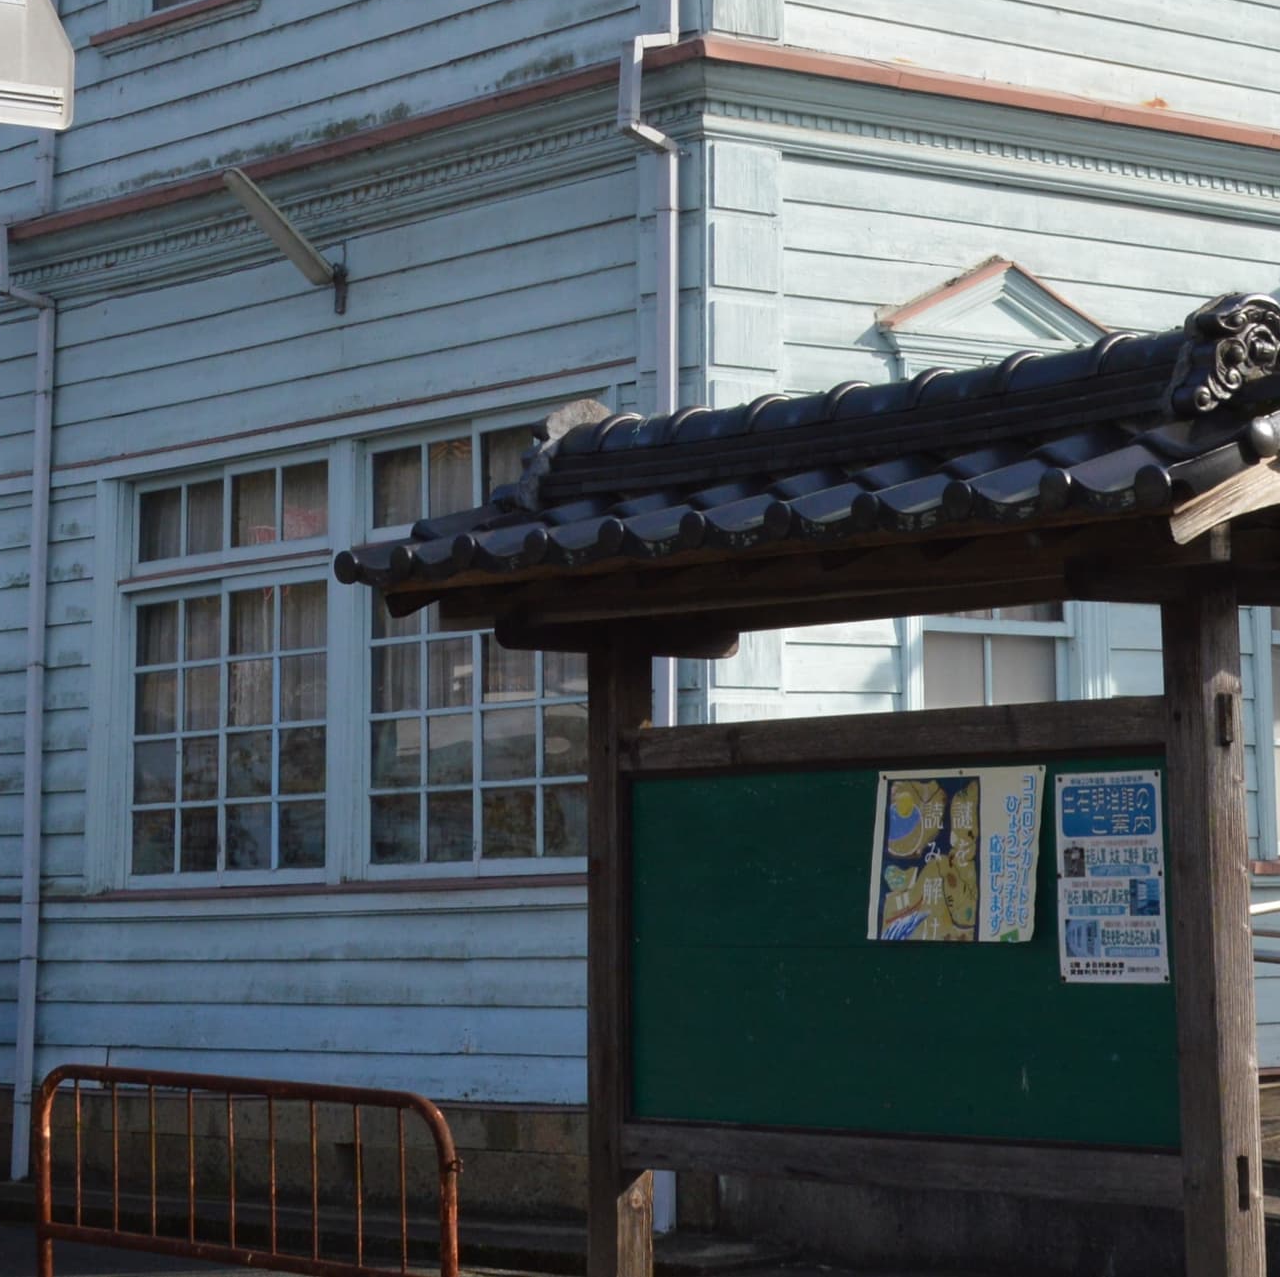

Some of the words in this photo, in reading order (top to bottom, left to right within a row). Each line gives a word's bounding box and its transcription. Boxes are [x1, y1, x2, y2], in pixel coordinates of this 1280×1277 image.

[922, 803, 945, 940] 読み解け
[951, 802, 974, 867] 謎を
[989, 835, 1005, 935] 応援します
[1017, 774, 1036, 928] ココロンカードで
